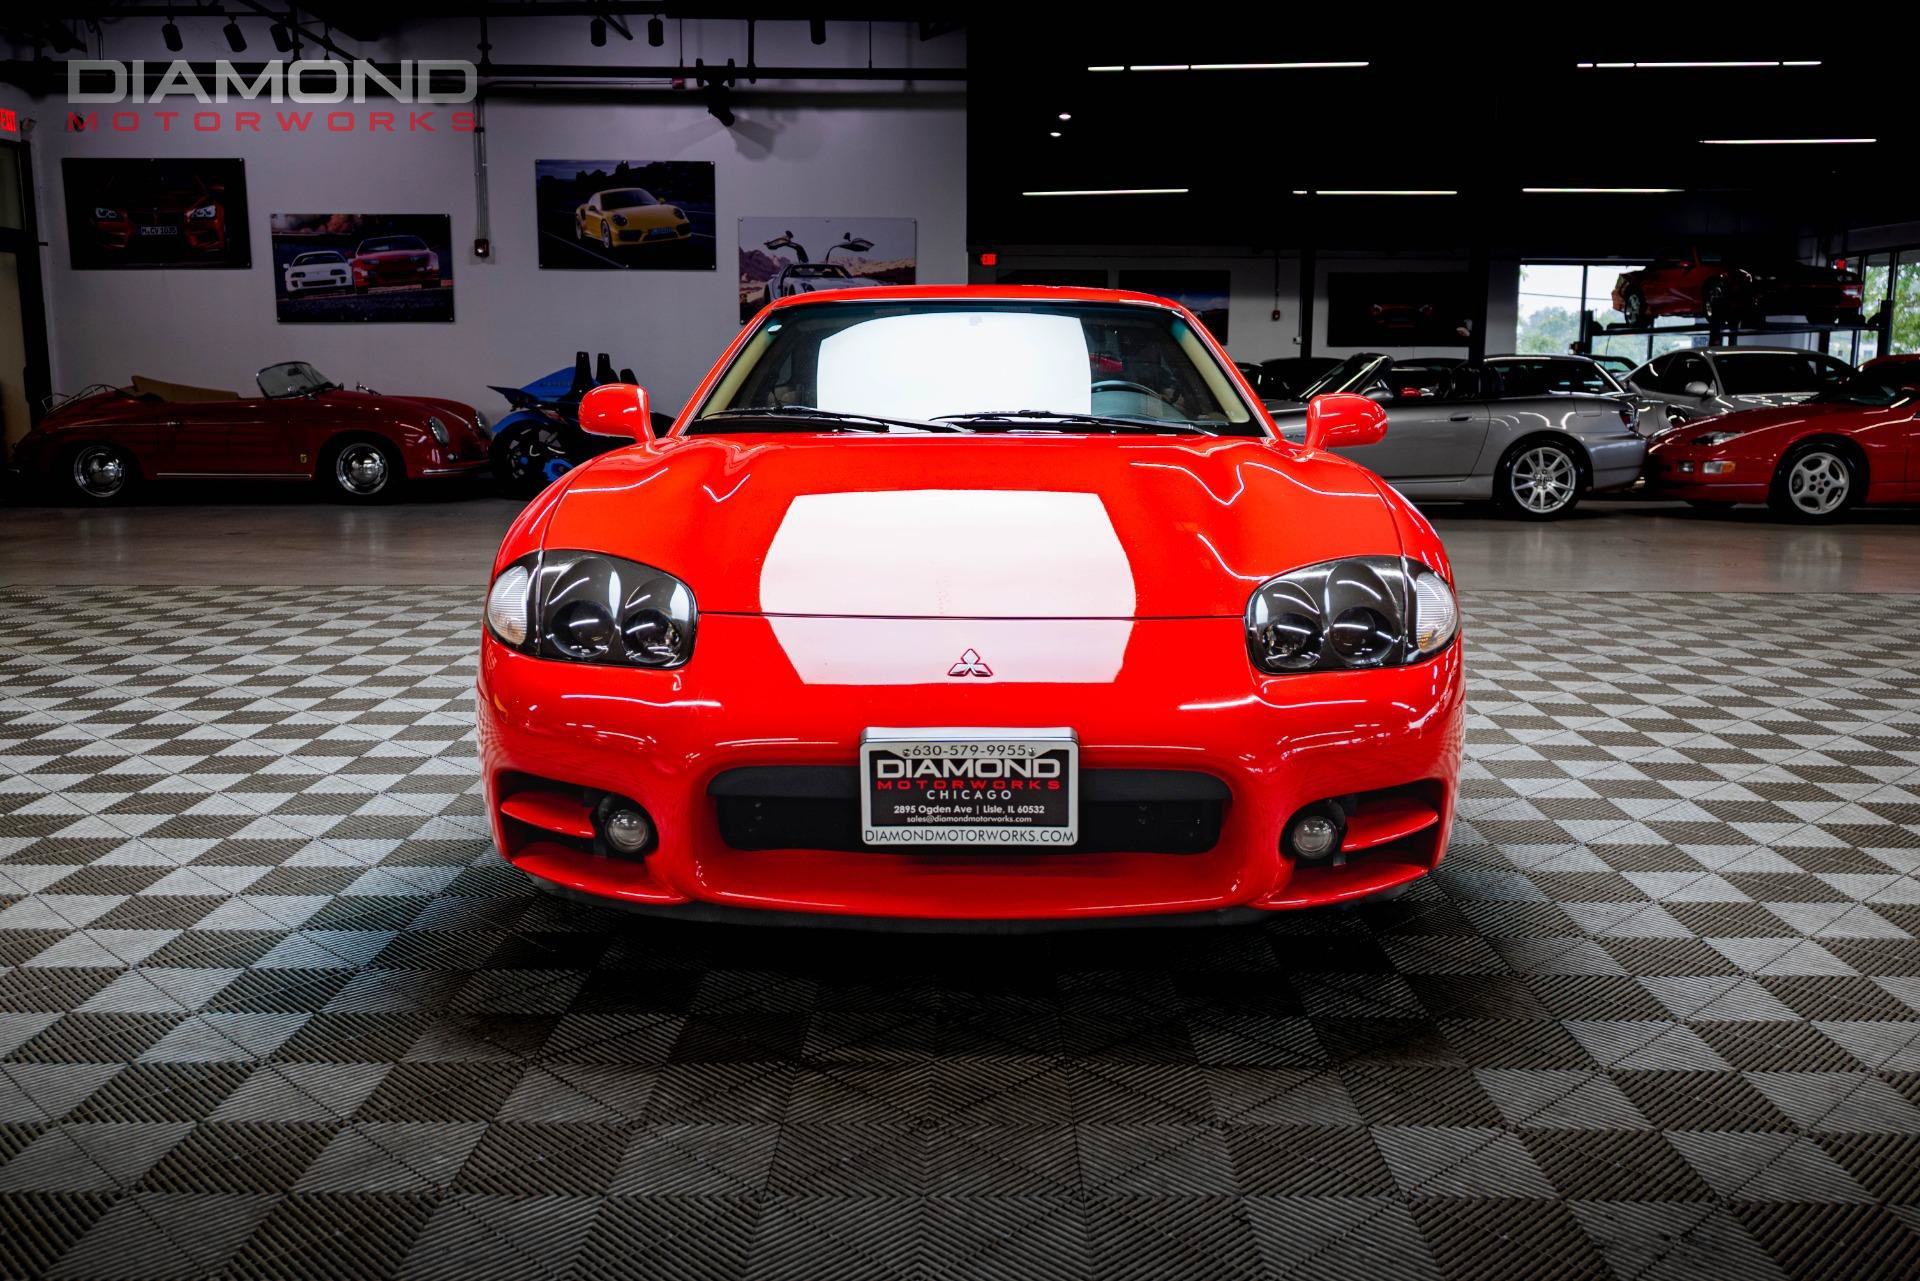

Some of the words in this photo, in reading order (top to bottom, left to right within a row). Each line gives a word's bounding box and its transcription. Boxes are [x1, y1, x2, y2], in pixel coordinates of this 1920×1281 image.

[912, 744, 1026, 756] 630-579-9955
[877, 758, 1061, 778] DIAMOND
[876, 780, 1061, 790] MOTORWORKS
[926, 790, 1012, 800] CHICAGO
[893, 805, 917, 814] 2895
[918, 805, 952, 815] Ogden
[953, 805, 973, 814] Ave
[983, 805, 1006, 815] Lisle,
[1007, 805, 1015, 814] IL
[1017, 805, 1046, 814] 60532
[906, 815, 1032, 823] sales@diamondmotorworks.com
[865, 829, 1075, 842] DIAMONDMOTORWORKS.COM
